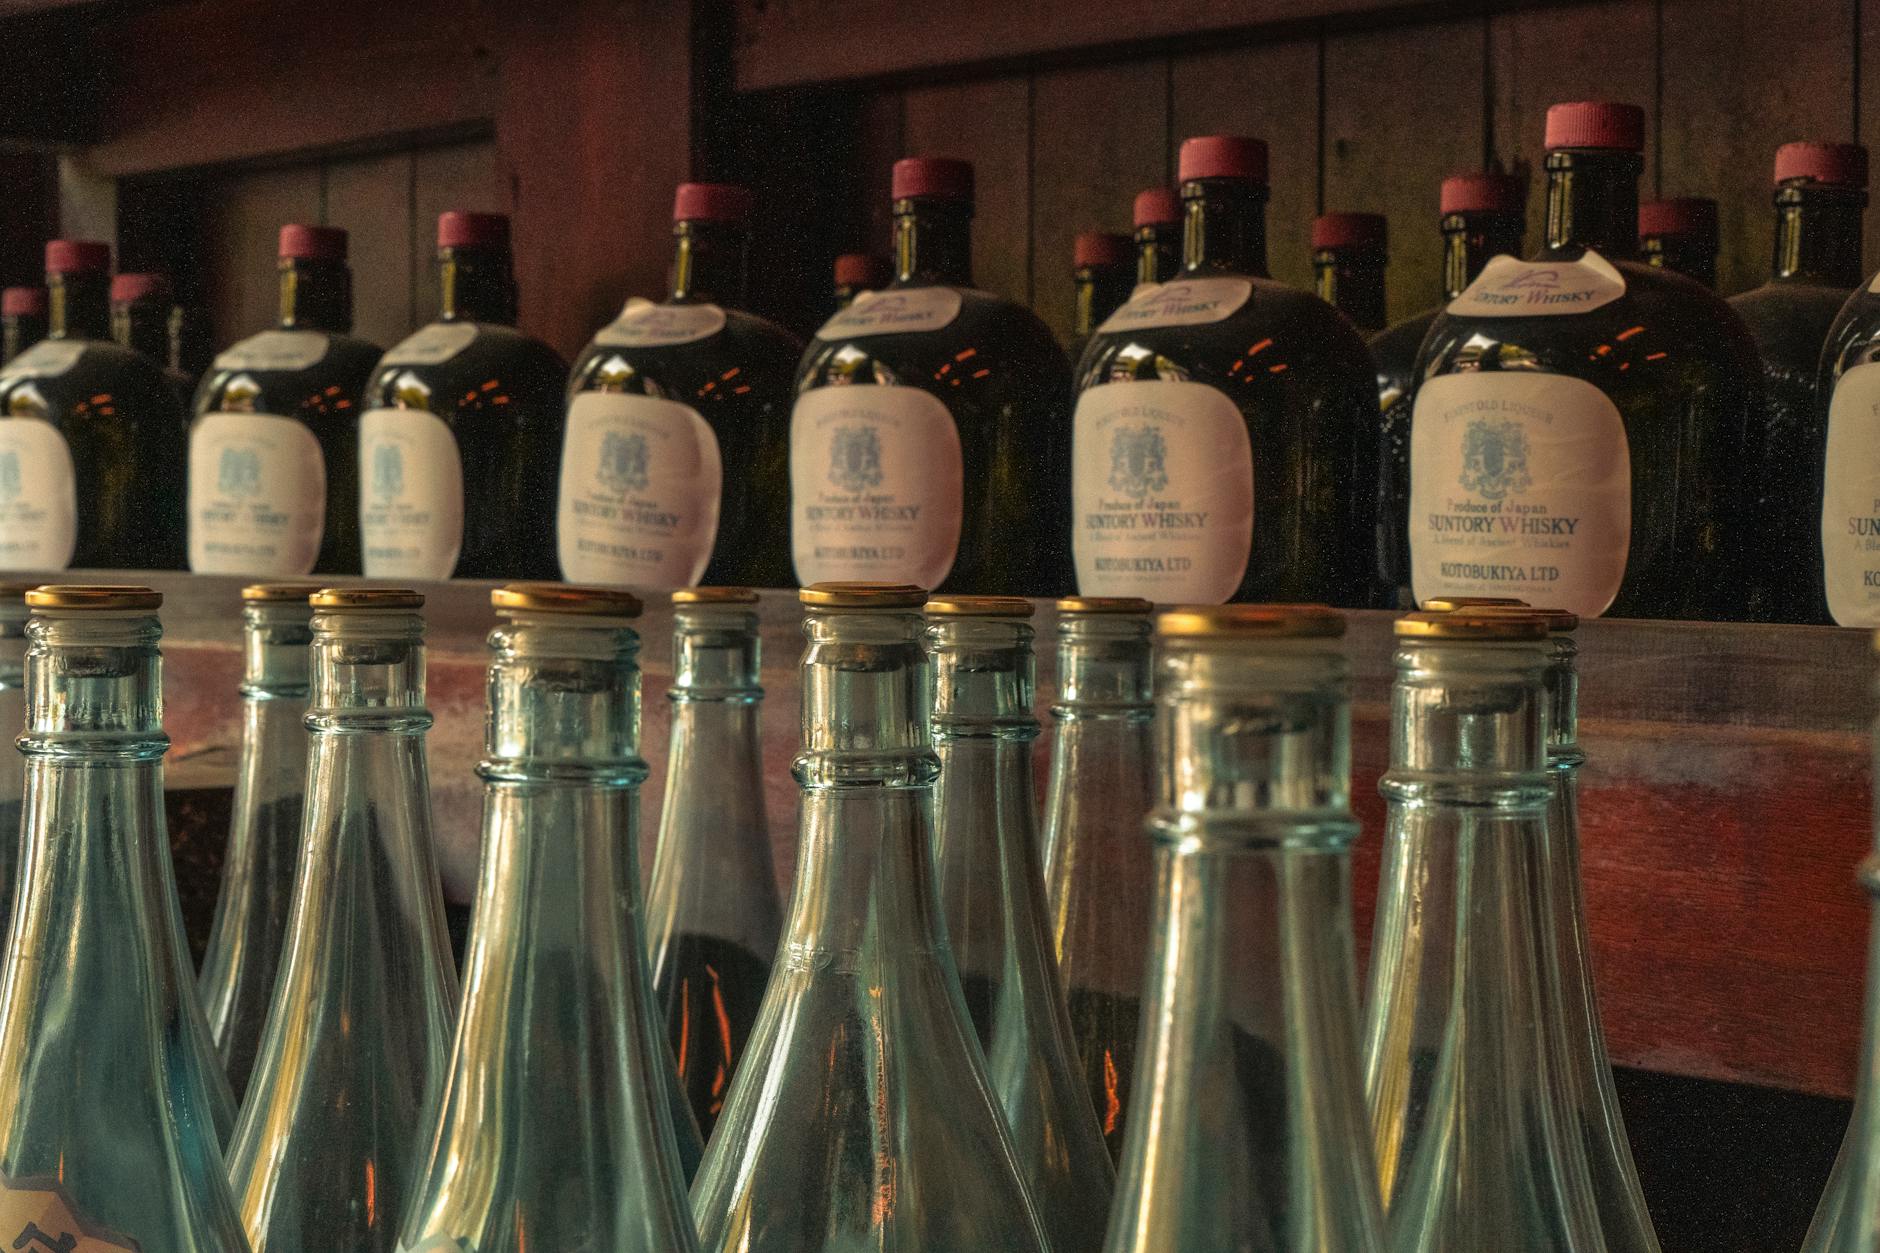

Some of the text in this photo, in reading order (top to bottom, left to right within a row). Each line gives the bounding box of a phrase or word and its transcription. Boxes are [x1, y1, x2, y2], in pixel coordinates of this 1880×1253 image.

[1448, 498, 1547, 515] Produce of Japan
[1141, 511, 1208, 529] WHISKY
[1429, 513, 1580, 536] SUNTORY WHISKY
[1440, 562, 1560, 581] KOTOBUKIYA LTD
